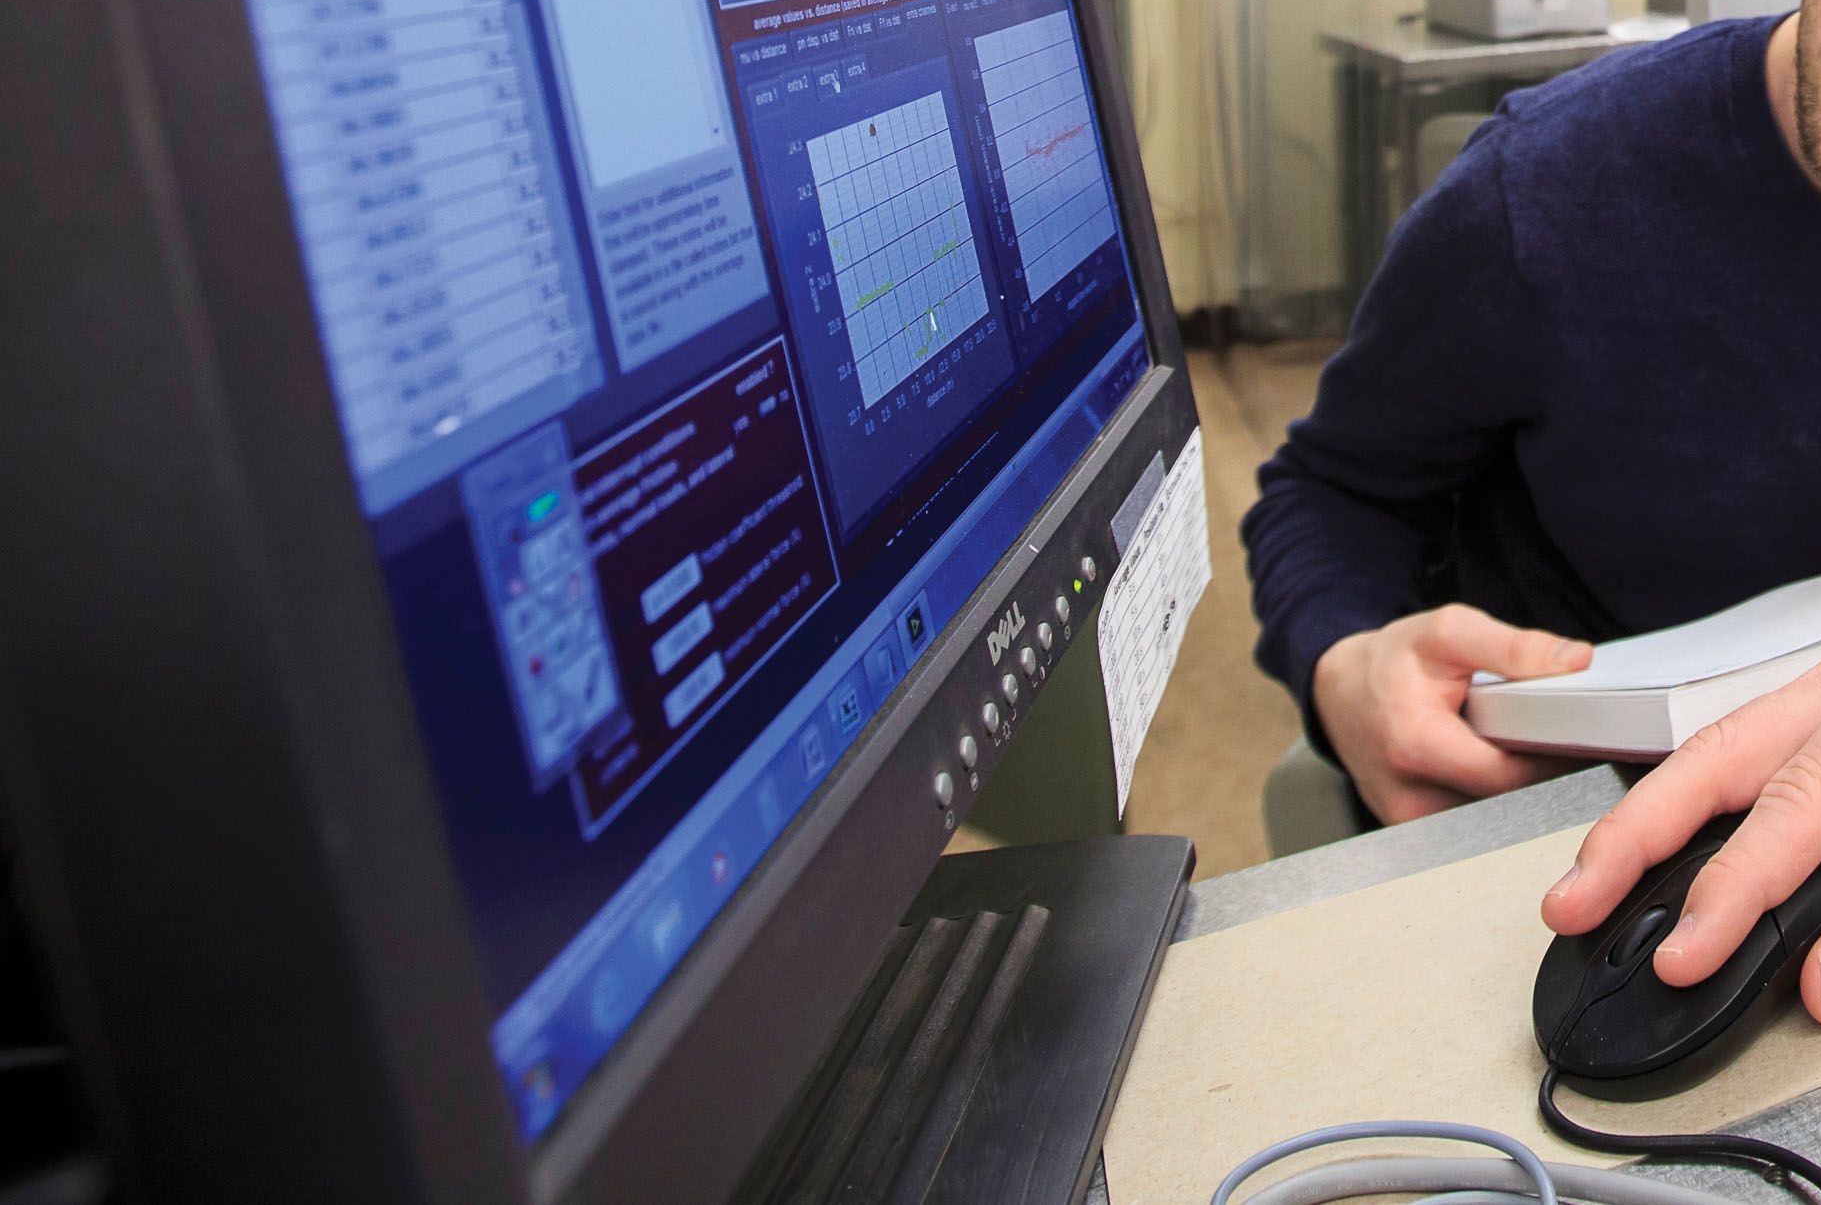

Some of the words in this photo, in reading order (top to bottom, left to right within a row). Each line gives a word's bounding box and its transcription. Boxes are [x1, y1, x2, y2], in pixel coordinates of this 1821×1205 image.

[753, 14, 782, 30] average
[781, 10, 805, 23] values
[815, 2, 841, 16] distance
[829, 29, 840, 42] dist
[750, 50, 760, 61] vs
[760, 43, 787, 59] distance
[819, 72, 835, 86] extra
[847, 65, 862, 77] extra
[787, 79, 803, 93] extra
[755, 90, 774, 106] extra
[797, 183, 813, 201] 24.2
[987, 601, 1026, 666] DELL
